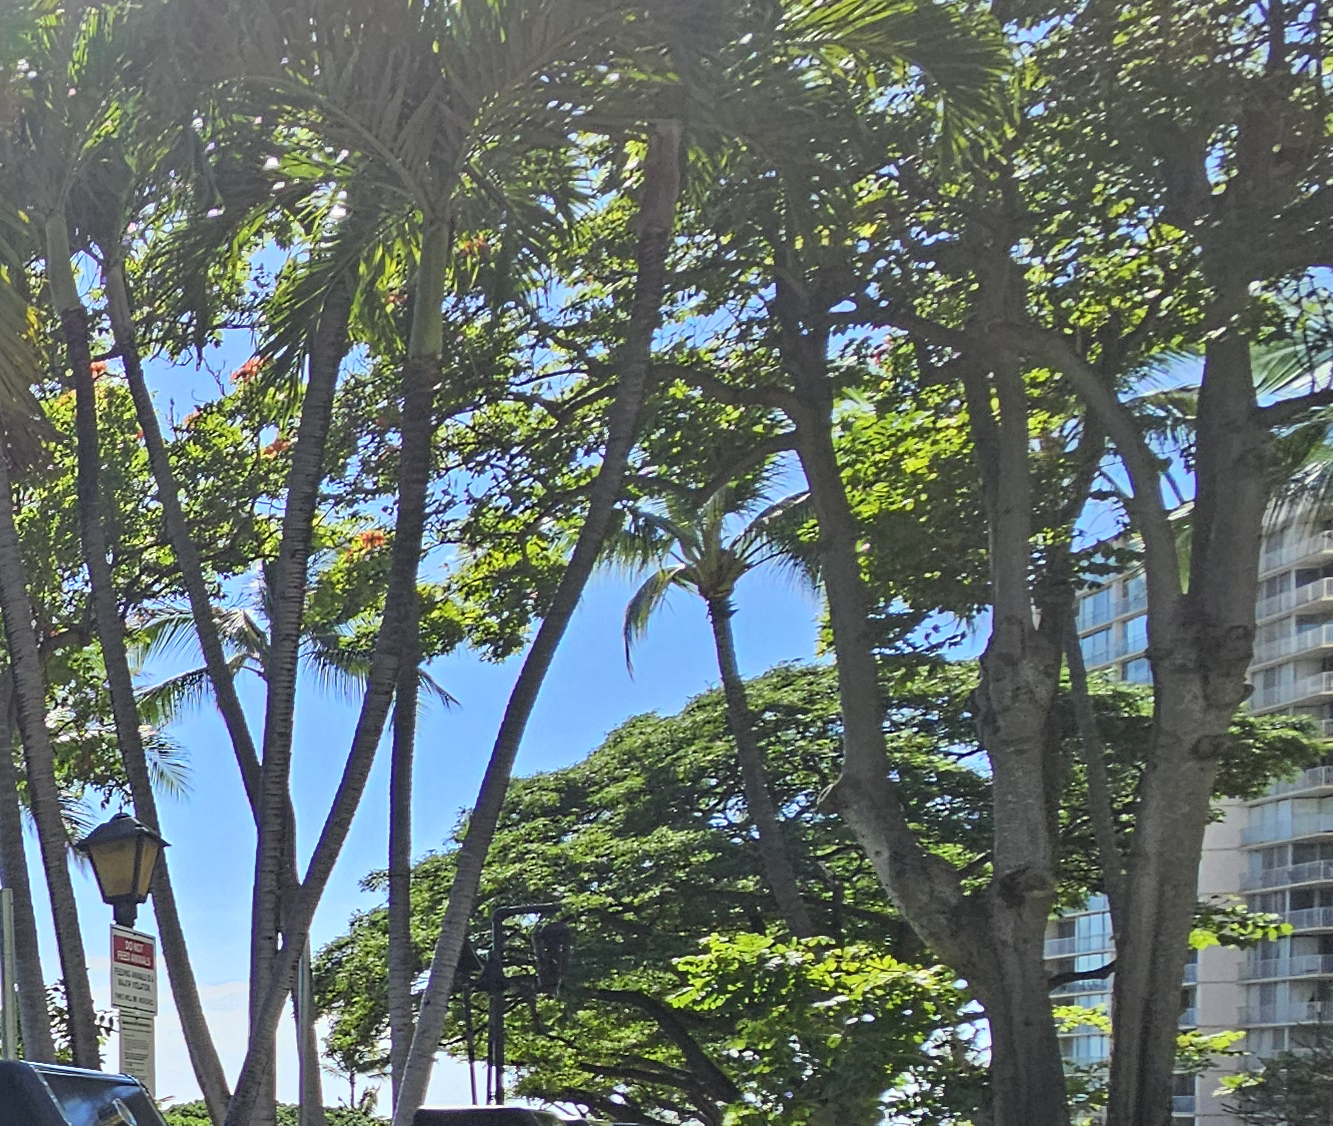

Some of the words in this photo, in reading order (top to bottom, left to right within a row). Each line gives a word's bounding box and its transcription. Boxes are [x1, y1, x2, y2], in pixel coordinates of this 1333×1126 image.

[125, 940, 133, 951] DO
[133, 942, 144, 953] NOT
[117, 950, 131, 961] FEED
[131, 953, 151, 966] ANIMALS
